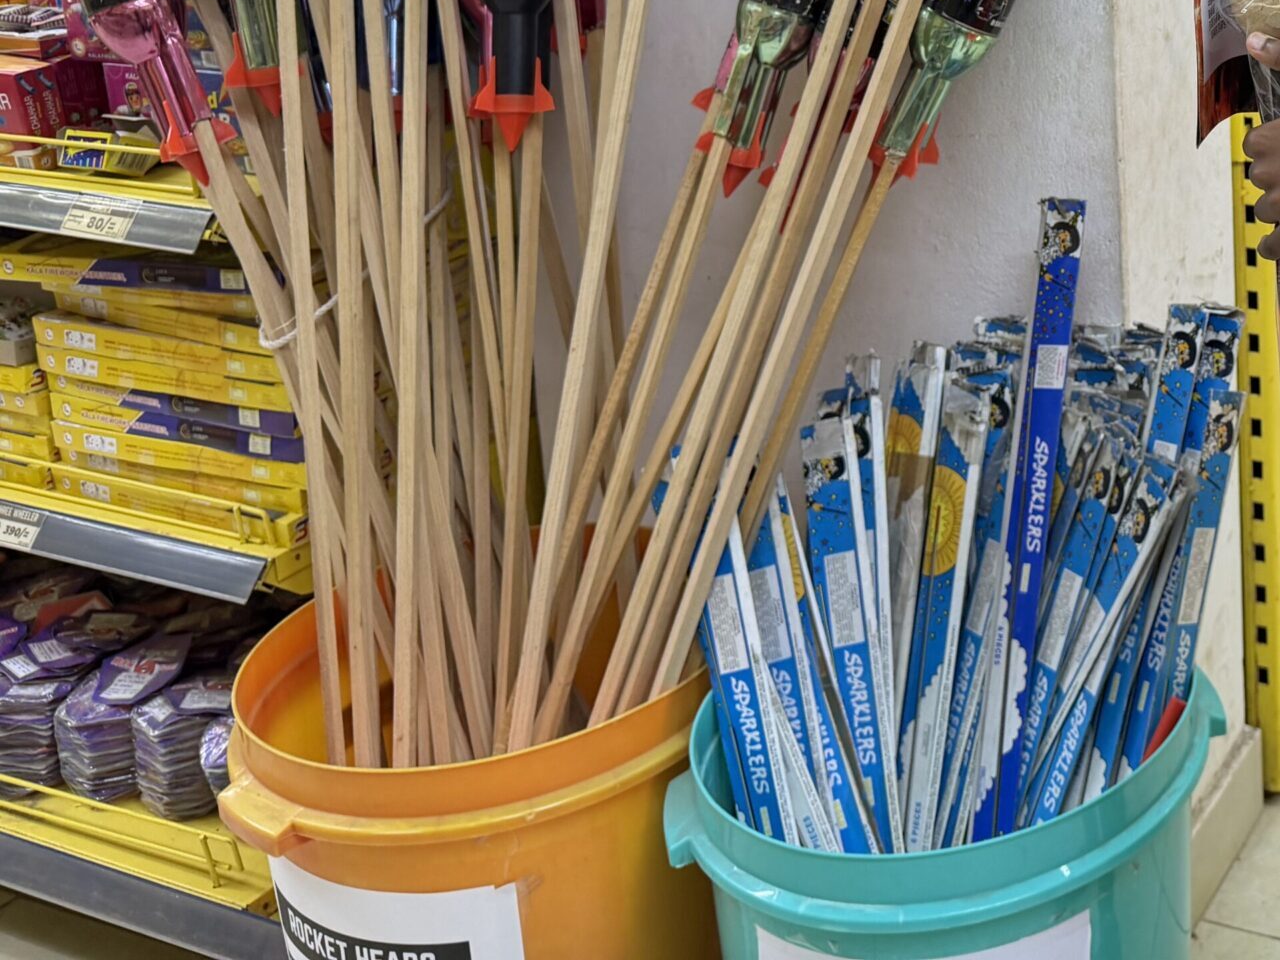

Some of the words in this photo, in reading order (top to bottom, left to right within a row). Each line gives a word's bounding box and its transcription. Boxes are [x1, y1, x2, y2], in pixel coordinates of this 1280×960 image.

[1026, 435, 1050, 554] SPARKLERS
[730, 676, 770, 795] SPARKLERS
[843, 649, 877, 766] SPARKLERS
[1043, 690, 1089, 814] SPARKLERS
[287, 907, 348, 960] ROCKET
